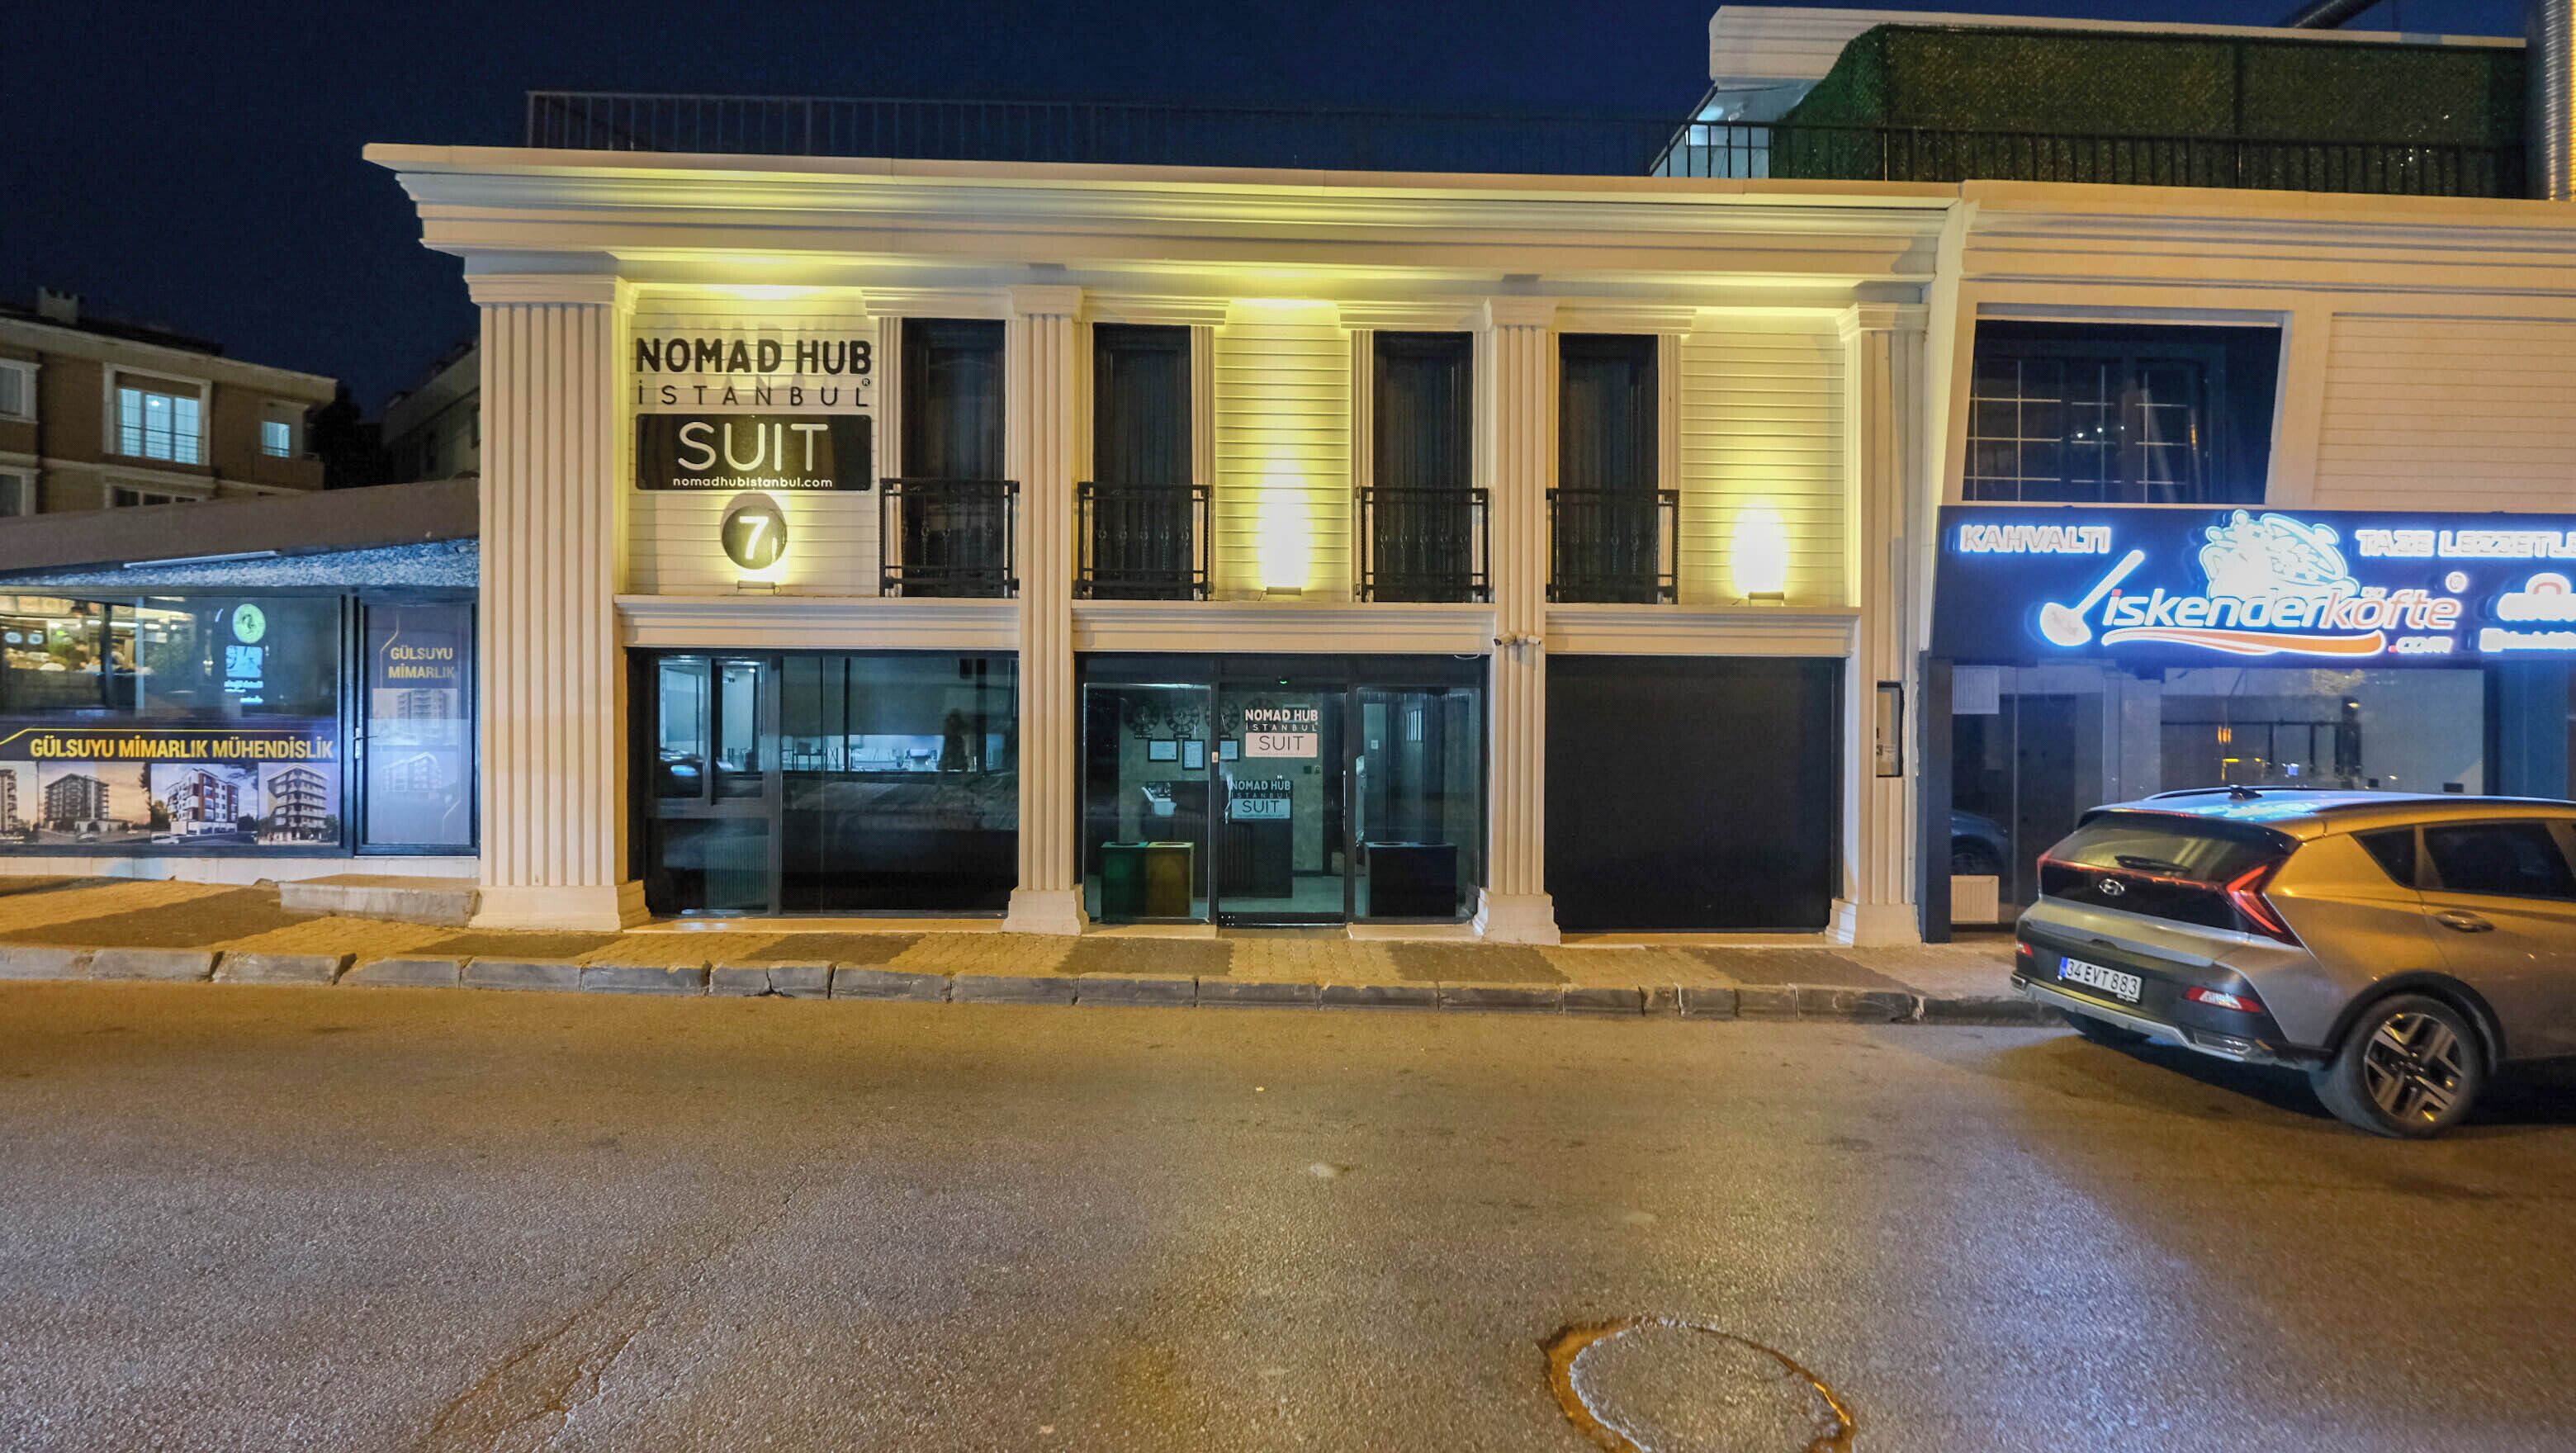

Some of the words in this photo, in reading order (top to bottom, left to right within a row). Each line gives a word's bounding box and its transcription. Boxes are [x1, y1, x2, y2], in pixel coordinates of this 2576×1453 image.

[636, 338, 783, 373] NOMAD
[795, 339, 872, 375] HUB
[677, 421, 829, 471] SUIT
[673, 476, 833, 488] nomadhubistanbul.com
[738, 515, 769, 560] 7
[1960, 524, 2111, 554] KAHVALTI
[2356, 529, 2435, 557] TAZE
[391, 645, 453, 660] GÜLSUYU
[388, 663, 455, 679] MİMARLIK
[1245, 708, 1291, 722] NOMAD
[1294, 709, 1319, 722] HUB
[30, 734, 115, 759] GÜLSUYU
[118, 734, 208, 759] MİMARLIK
[212, 736, 334, 760] MÜHENDİSLİK
[1258, 735, 1305, 751] SUIT
[1231, 780, 1268, 791] NOMAD
[1271, 780, 1291, 791] HUB
[1242, 800, 1280, 813] SUIT
[2067, 961, 2082, 977] 34
[2110, 973, 2138, 996] 883
